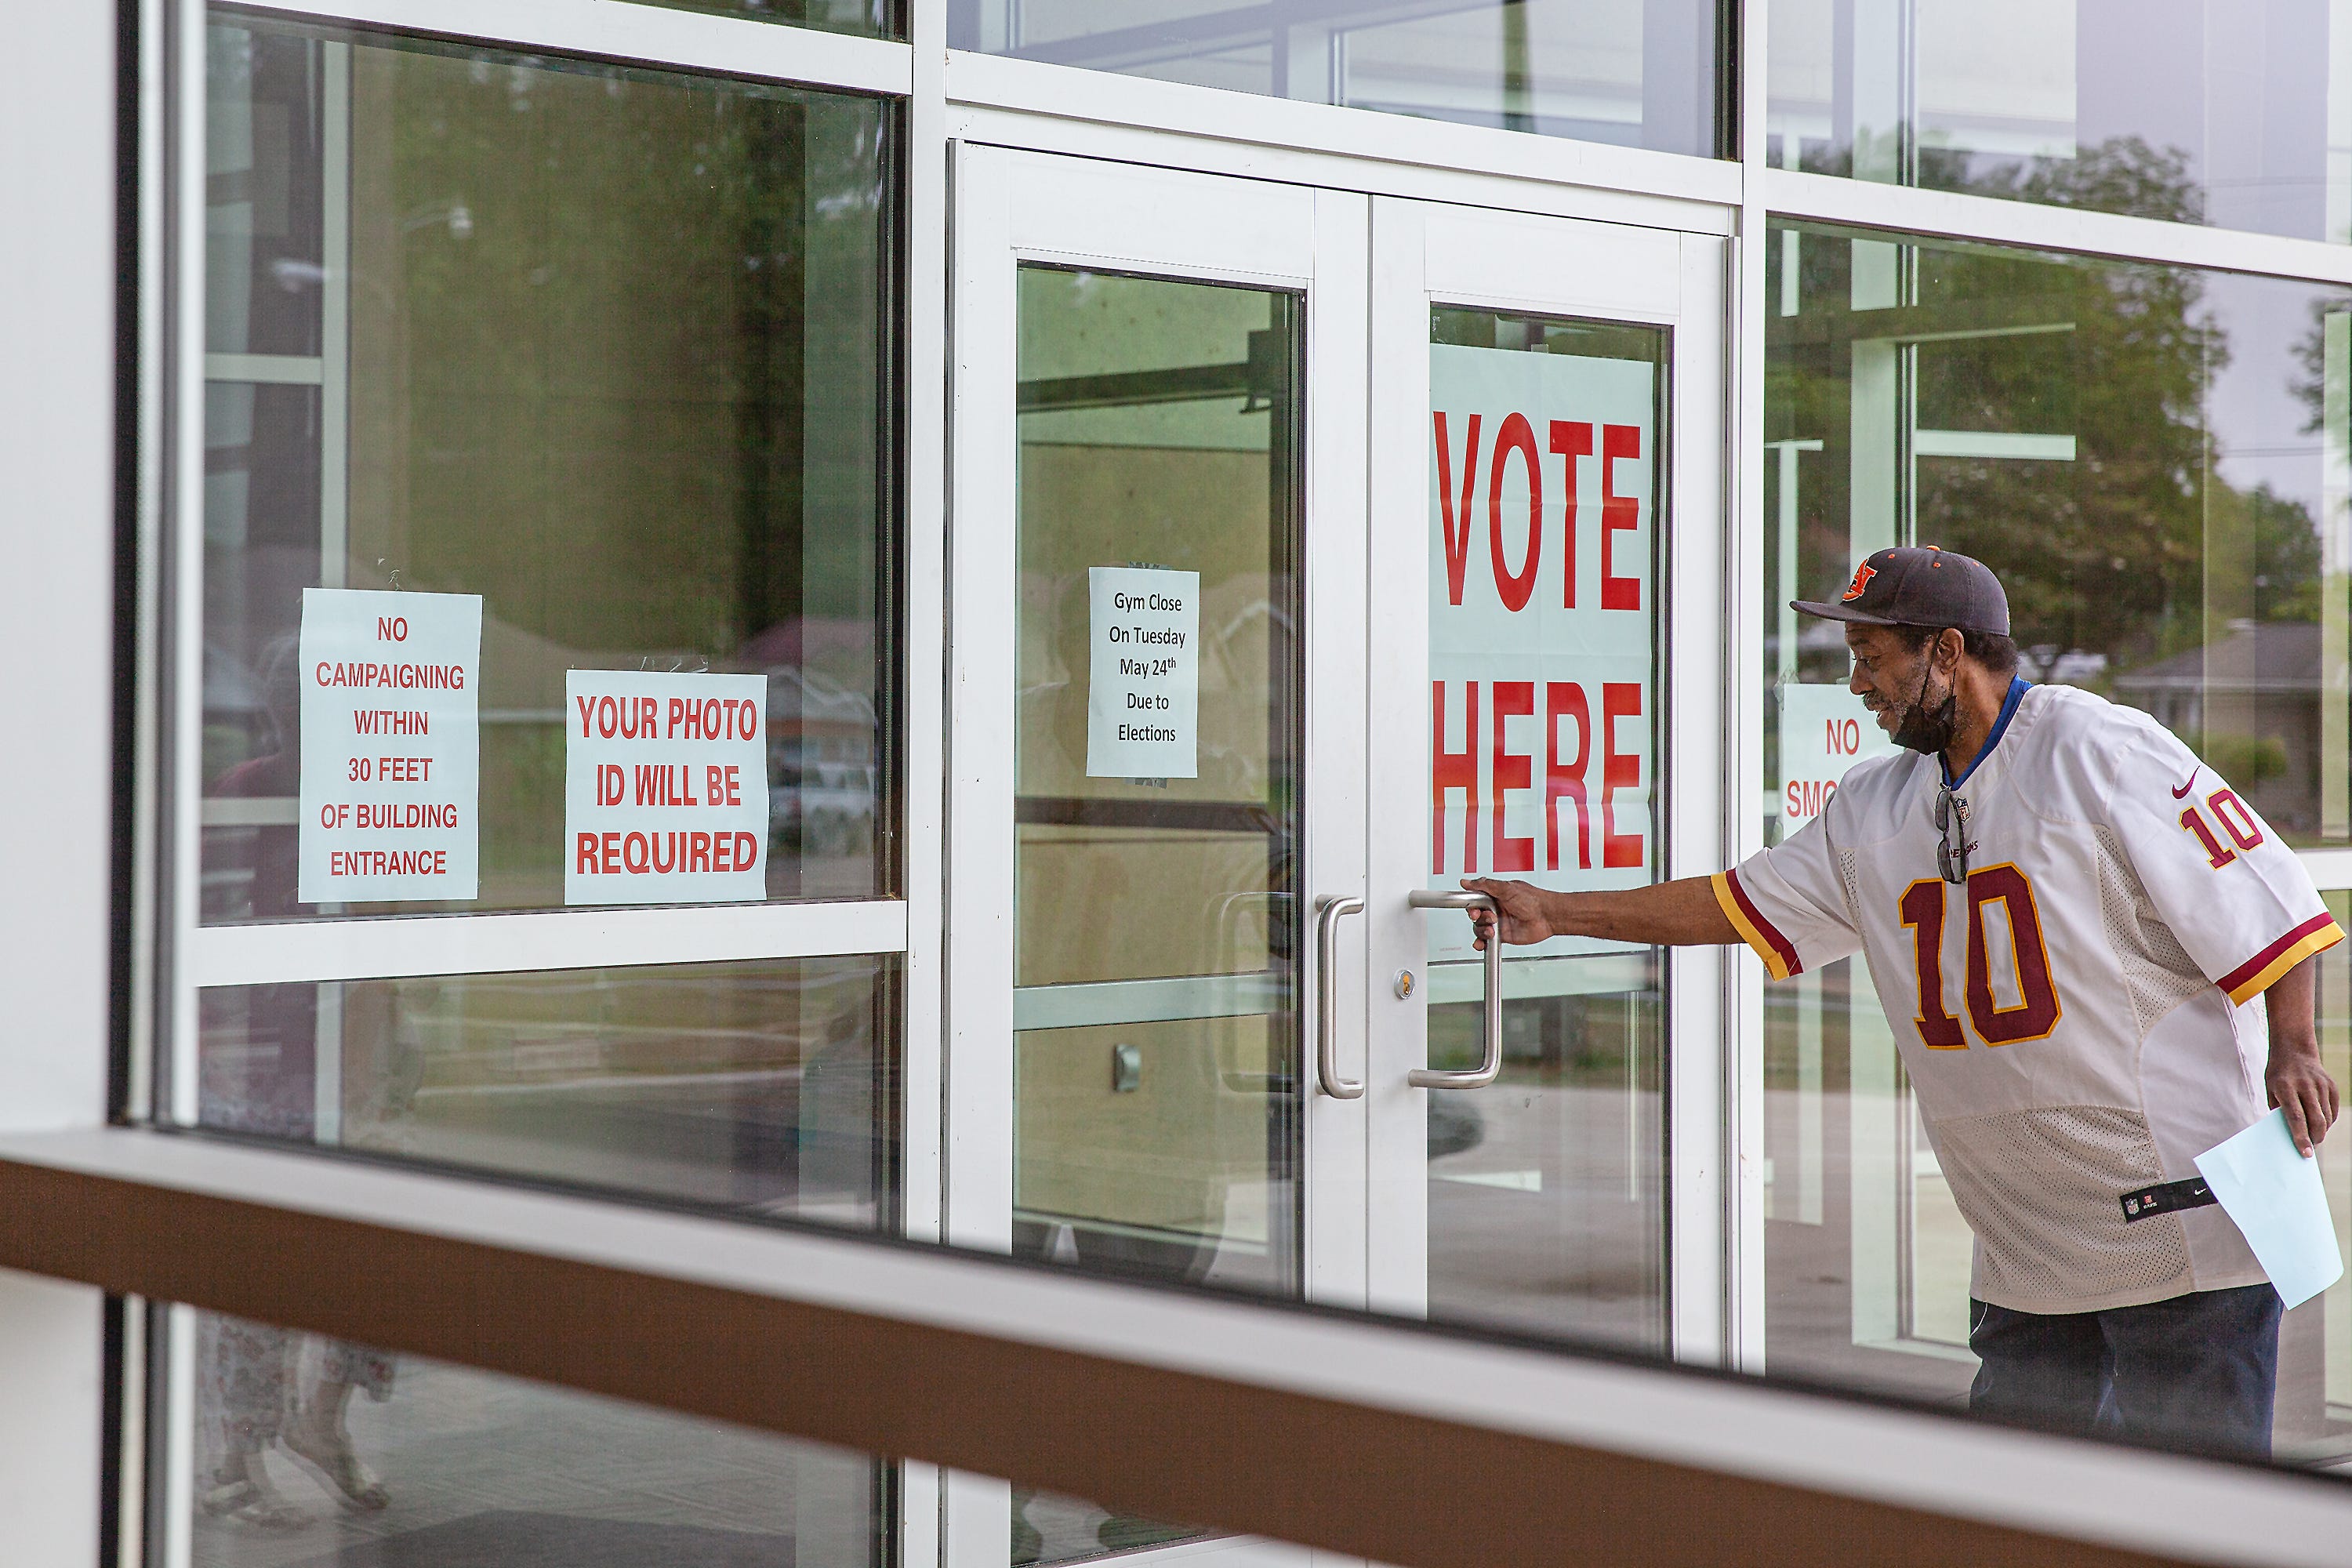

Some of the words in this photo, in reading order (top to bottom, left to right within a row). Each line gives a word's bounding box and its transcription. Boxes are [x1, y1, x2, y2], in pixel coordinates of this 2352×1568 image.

[1432, 411, 1641, 612] VOTE
[1114, 592, 1145, 614] Gym
[1149, 593, 1182, 612] Close
[378, 617, 408, 642] NO
[1109, 626, 1130, 643] On
[1133, 626, 1186, 649] Tuesday
[316, 662, 463, 690] CAMPAIGNING
[1120, 658, 1149, 680] May
[1152, 656, 1177, 677] 24th
[1127, 692, 1152, 710] Due
[1155, 694, 1169, 710] to
[354, 710, 428, 735] WITHIN
[576, 695, 658, 739] YOUR
[667, 698, 757, 741] PHOTO
[1118, 723, 1176, 742] Elections
[1826, 718, 1860, 756] NO
[349, 757, 371, 782] 30
[379, 757, 433, 782] FEET
[1432, 680, 1644, 875] HERE
[597, 764, 625, 807] ID
[634, 764, 698, 807] WILL
[706, 765, 741, 807] BE
[321, 804, 350, 829] OF
[357, 804, 457, 829] BUILDING
[2179, 787, 2263, 871] 10
[331, 850, 446, 876] ENTRANCE
[576, 831, 758, 874] REQUIRED
[1898, 861, 2063, 1050] 10
